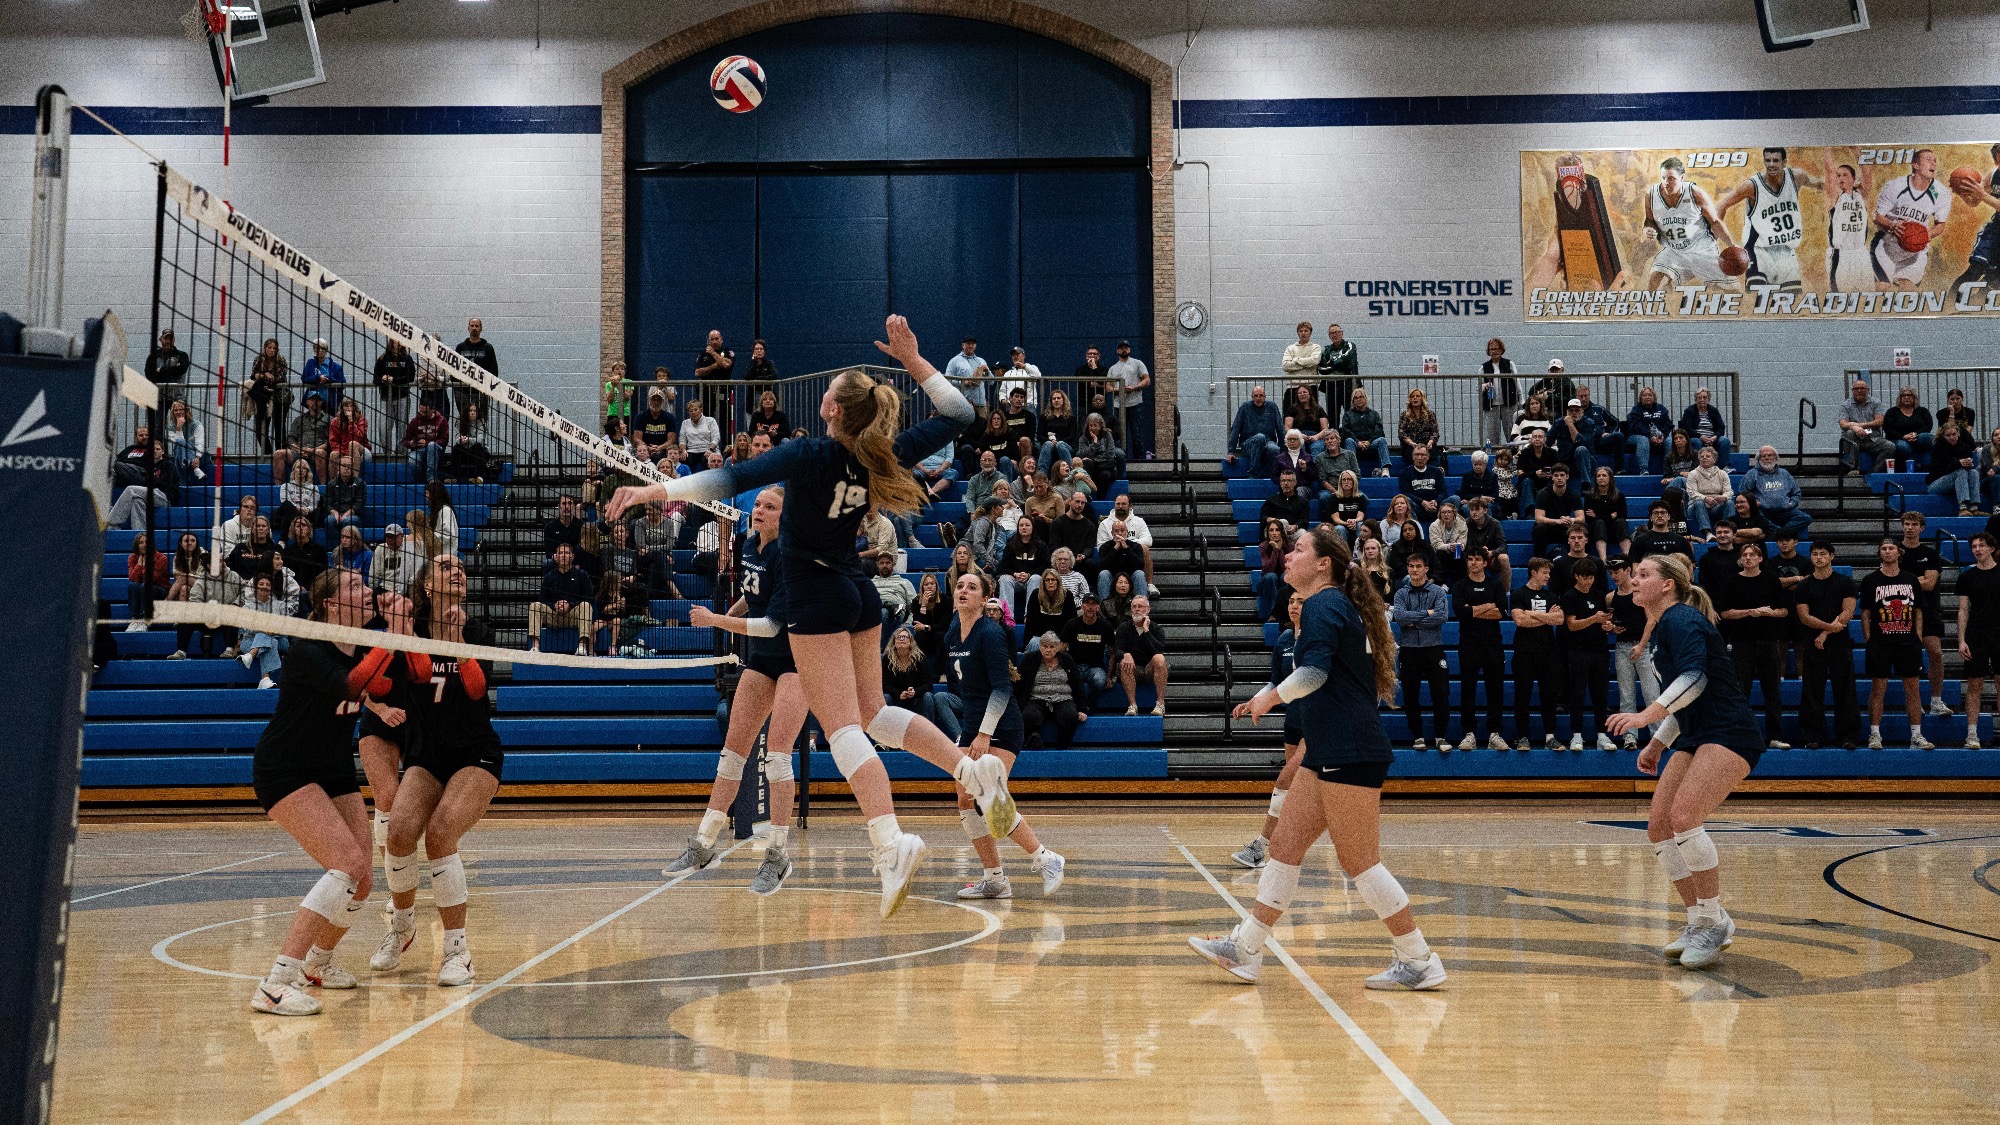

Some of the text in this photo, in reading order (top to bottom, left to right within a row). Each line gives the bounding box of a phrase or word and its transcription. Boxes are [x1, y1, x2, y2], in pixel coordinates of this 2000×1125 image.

[1687, 151, 1749, 168] 1999
[1858, 149, 1915, 165] 2011
[1761, 201, 1798, 219] GOLDEN
[1850, 211, 1863, 222] 24
[1895, 206, 1928, 223] GOLDEN
[1770, 214, 1795, 233] 30
[1666, 228, 1687, 241] 42
[1768, 229, 1801, 246] EAGLES
[1344, 280, 1513, 297] CORNERSTONE
[1531, 287, 1667, 303] CORNERSTONE
[1368, 300, 1489, 317] STUDENTS
[1675, 285, 1743, 316] THE
[1750, 284, 1947, 315] TRADITION
[1528, 302, 1670, 317] BASKETBALL
[14, 455, 76, 472] SPORTS
[828, 480, 868, 519] 19
[743, 569, 760, 595] 23
[430, 676, 446, 703] 7
[757, 733, 766, 815] EAGLES
